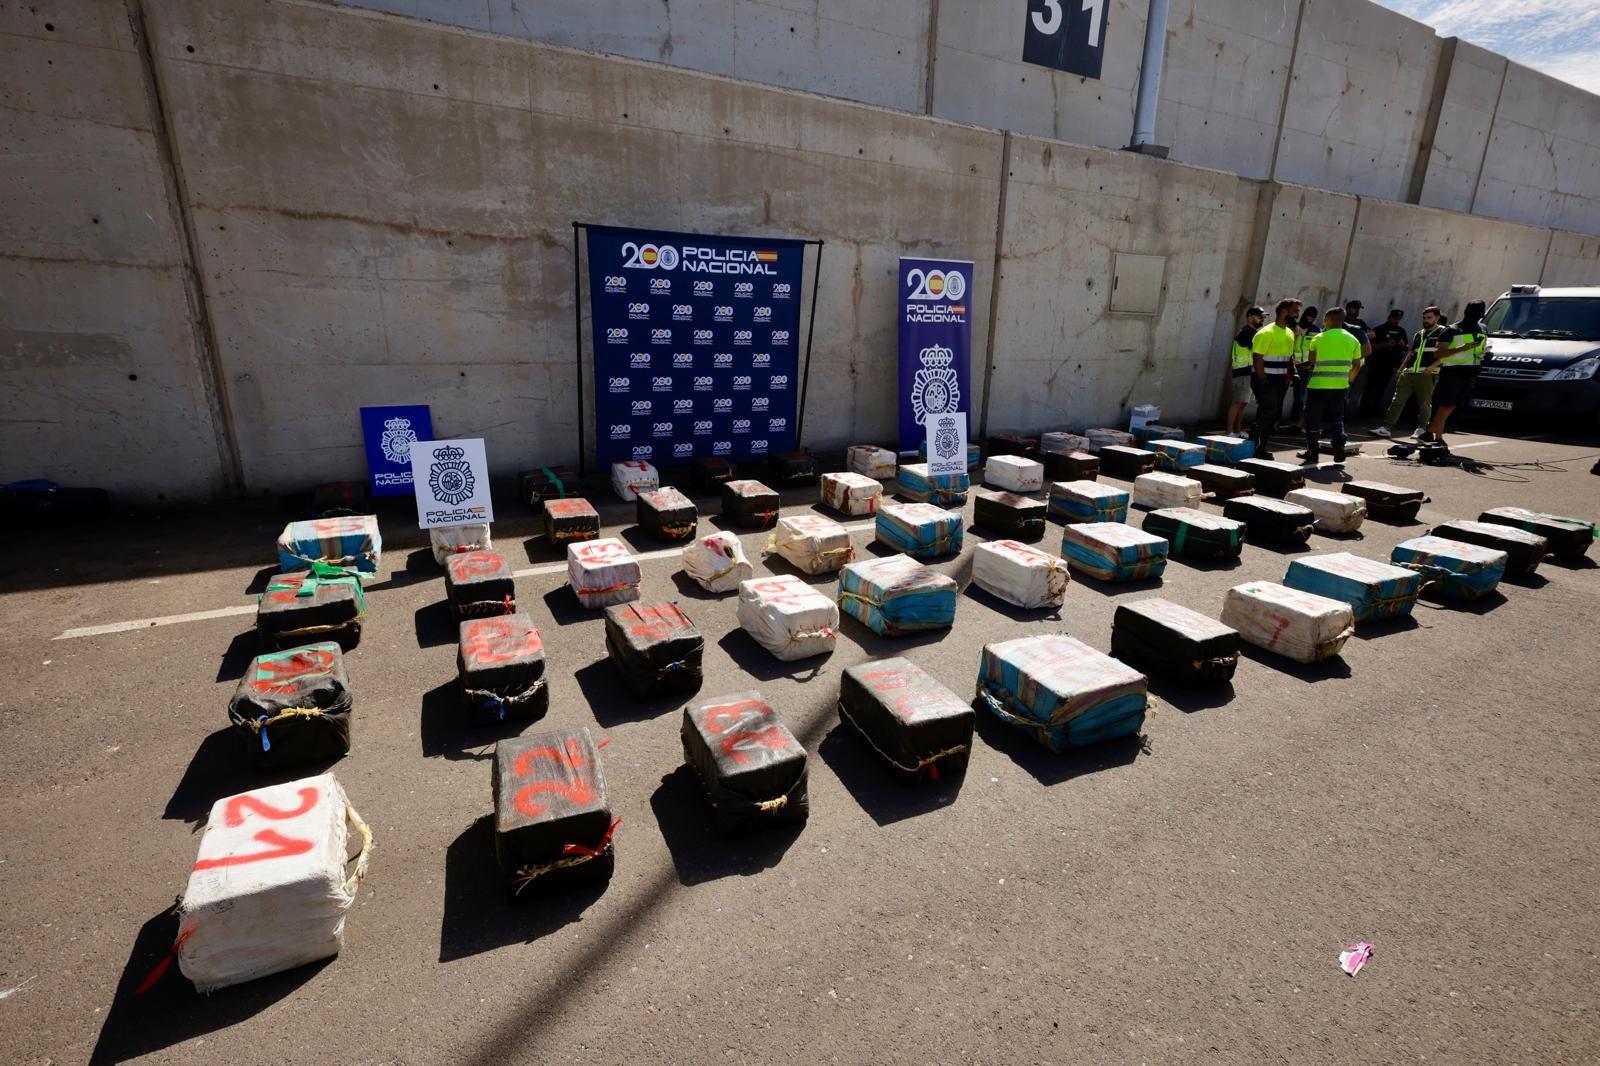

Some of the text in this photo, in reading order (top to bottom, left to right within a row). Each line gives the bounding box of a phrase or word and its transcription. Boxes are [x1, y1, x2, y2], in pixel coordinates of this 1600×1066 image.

[621, 242, 679, 270] 200
[682, 260, 777, 275] NACIONAL
[906, 268, 966, 301] 200
[906, 314, 965, 323] NACIONAL
[374, 471, 412, 479] POLIC
[375, 478, 412, 486] NACIO
[426, 513, 486, 525] NACIONAL
[192, 787, 320, 873] 21
